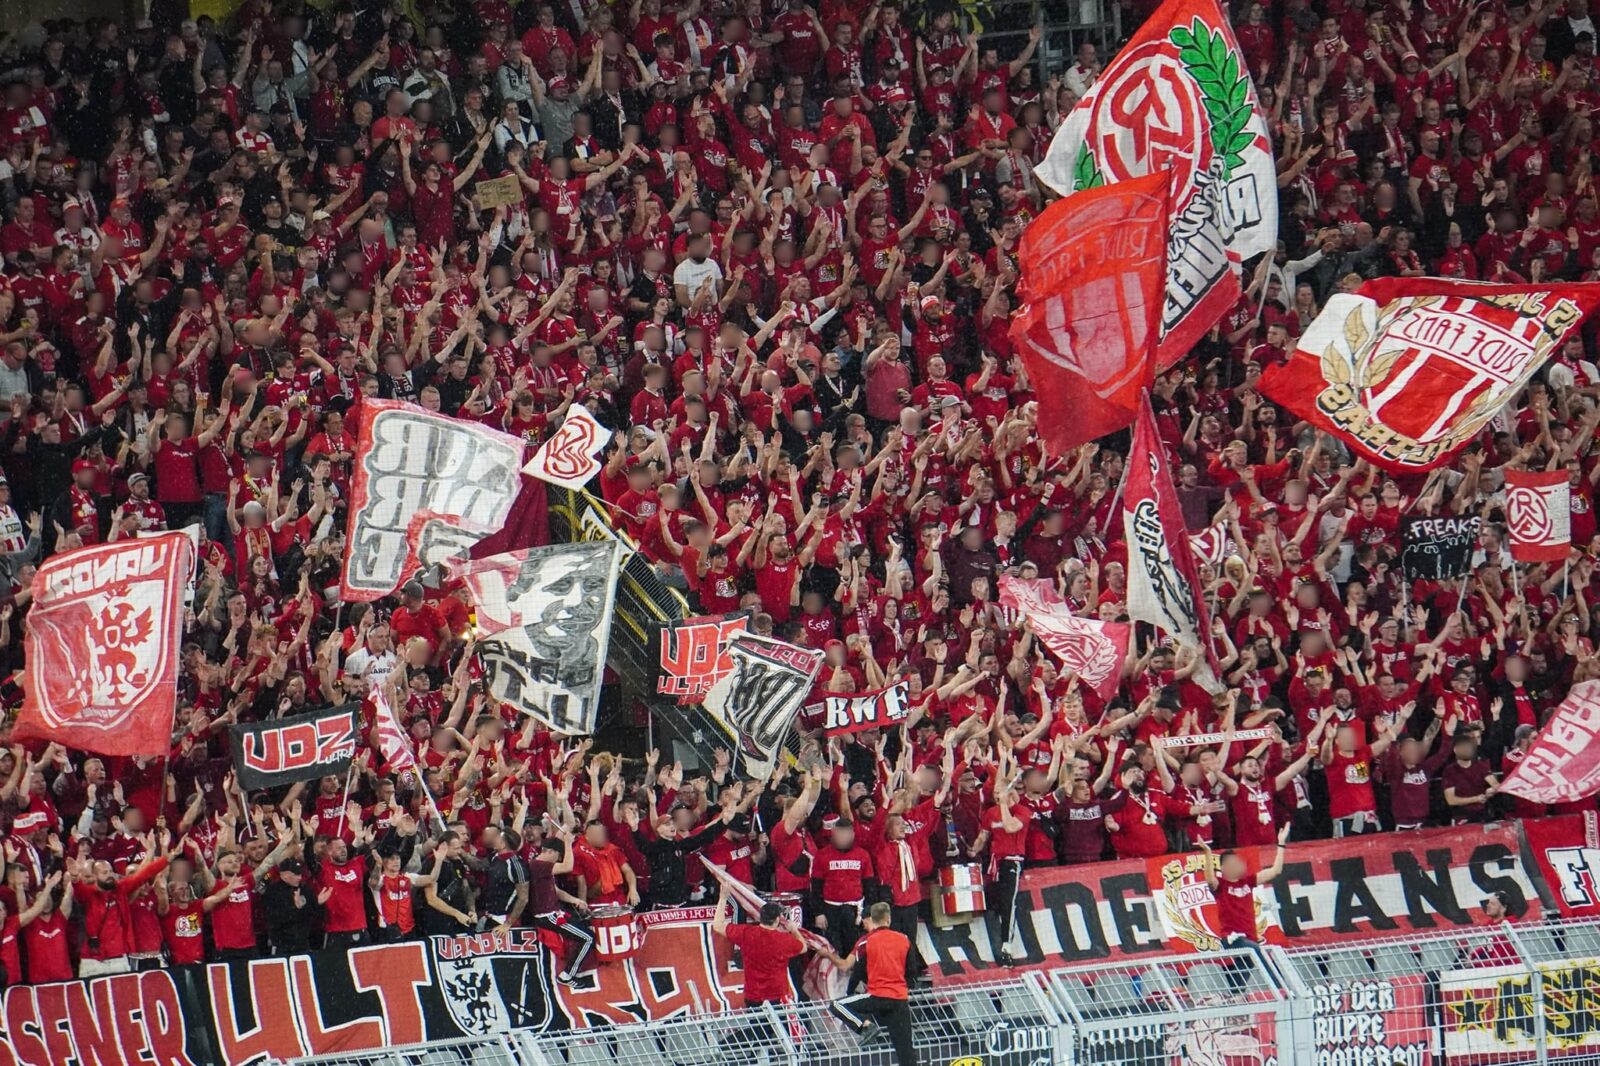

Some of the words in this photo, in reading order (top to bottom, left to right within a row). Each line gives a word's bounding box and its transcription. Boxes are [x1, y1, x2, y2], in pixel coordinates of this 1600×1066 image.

[1410, 515, 1481, 539] FREAKS
[243, 711, 355, 773] UDZ
[1265, 843, 1528, 937] FANS
[660, 909, 688, 922] IMMER
